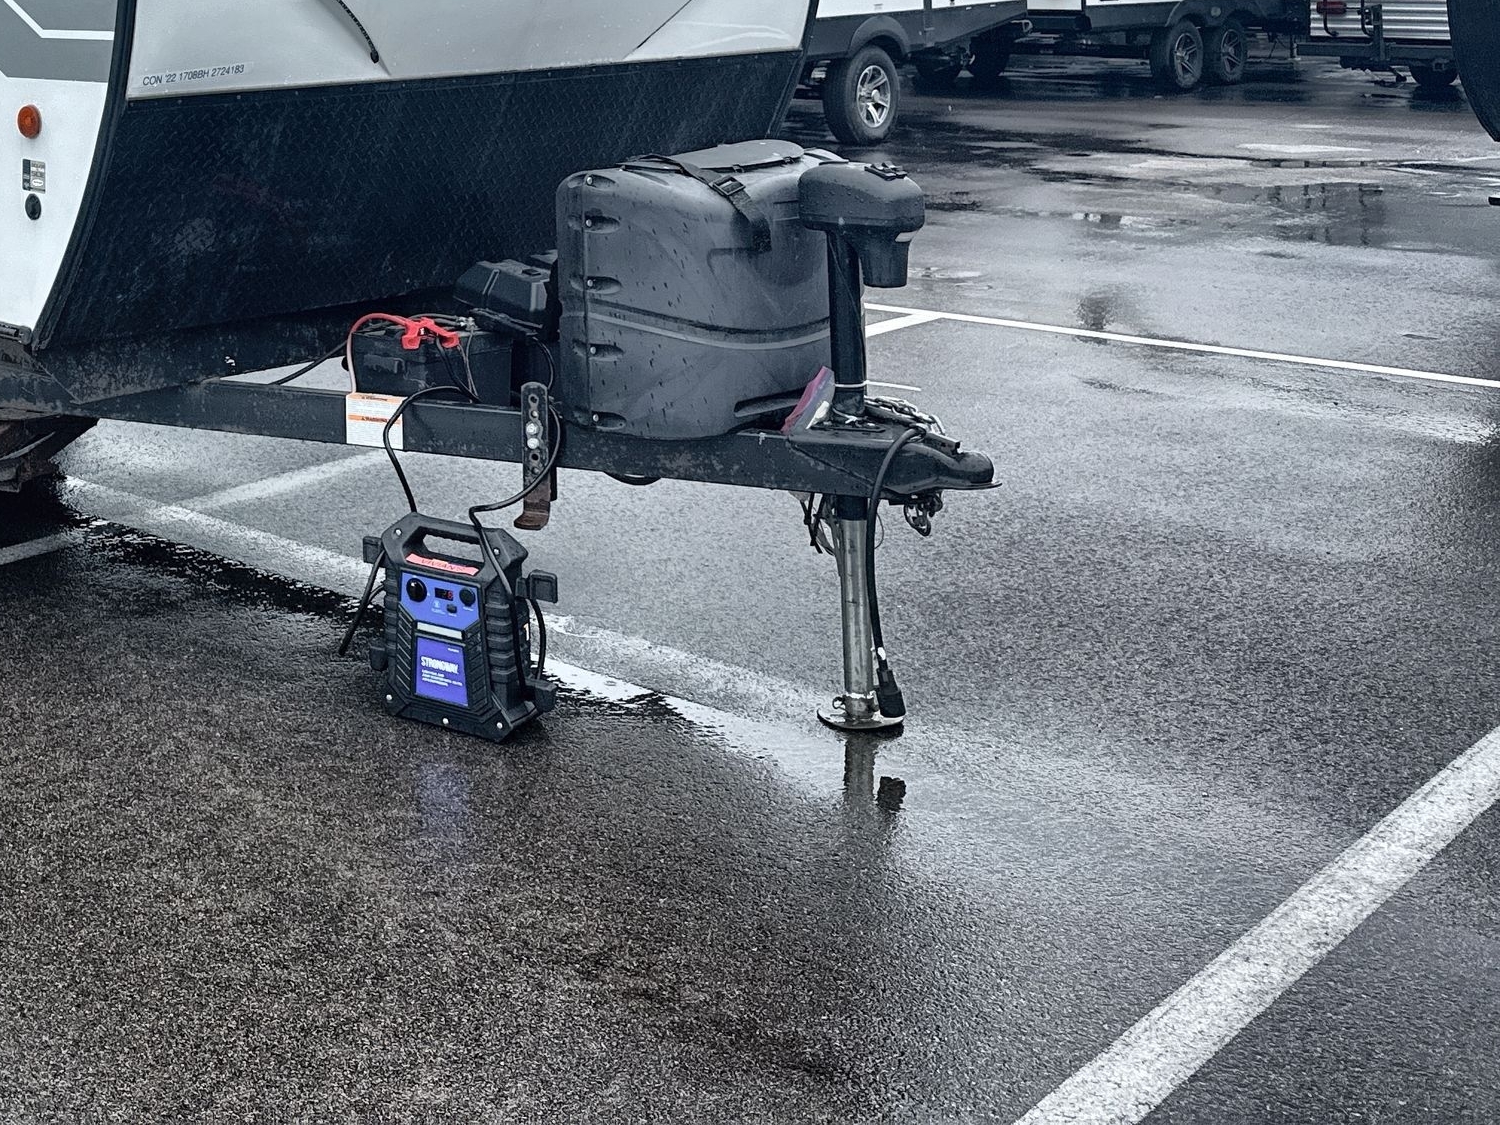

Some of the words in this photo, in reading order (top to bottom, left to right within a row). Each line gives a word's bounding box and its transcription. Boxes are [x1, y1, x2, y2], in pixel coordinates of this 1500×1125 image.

[142, 75, 163, 86] CON
[211, 64, 245, 77] 2724183
[420, 656, 459, 675] STRONGWAY
